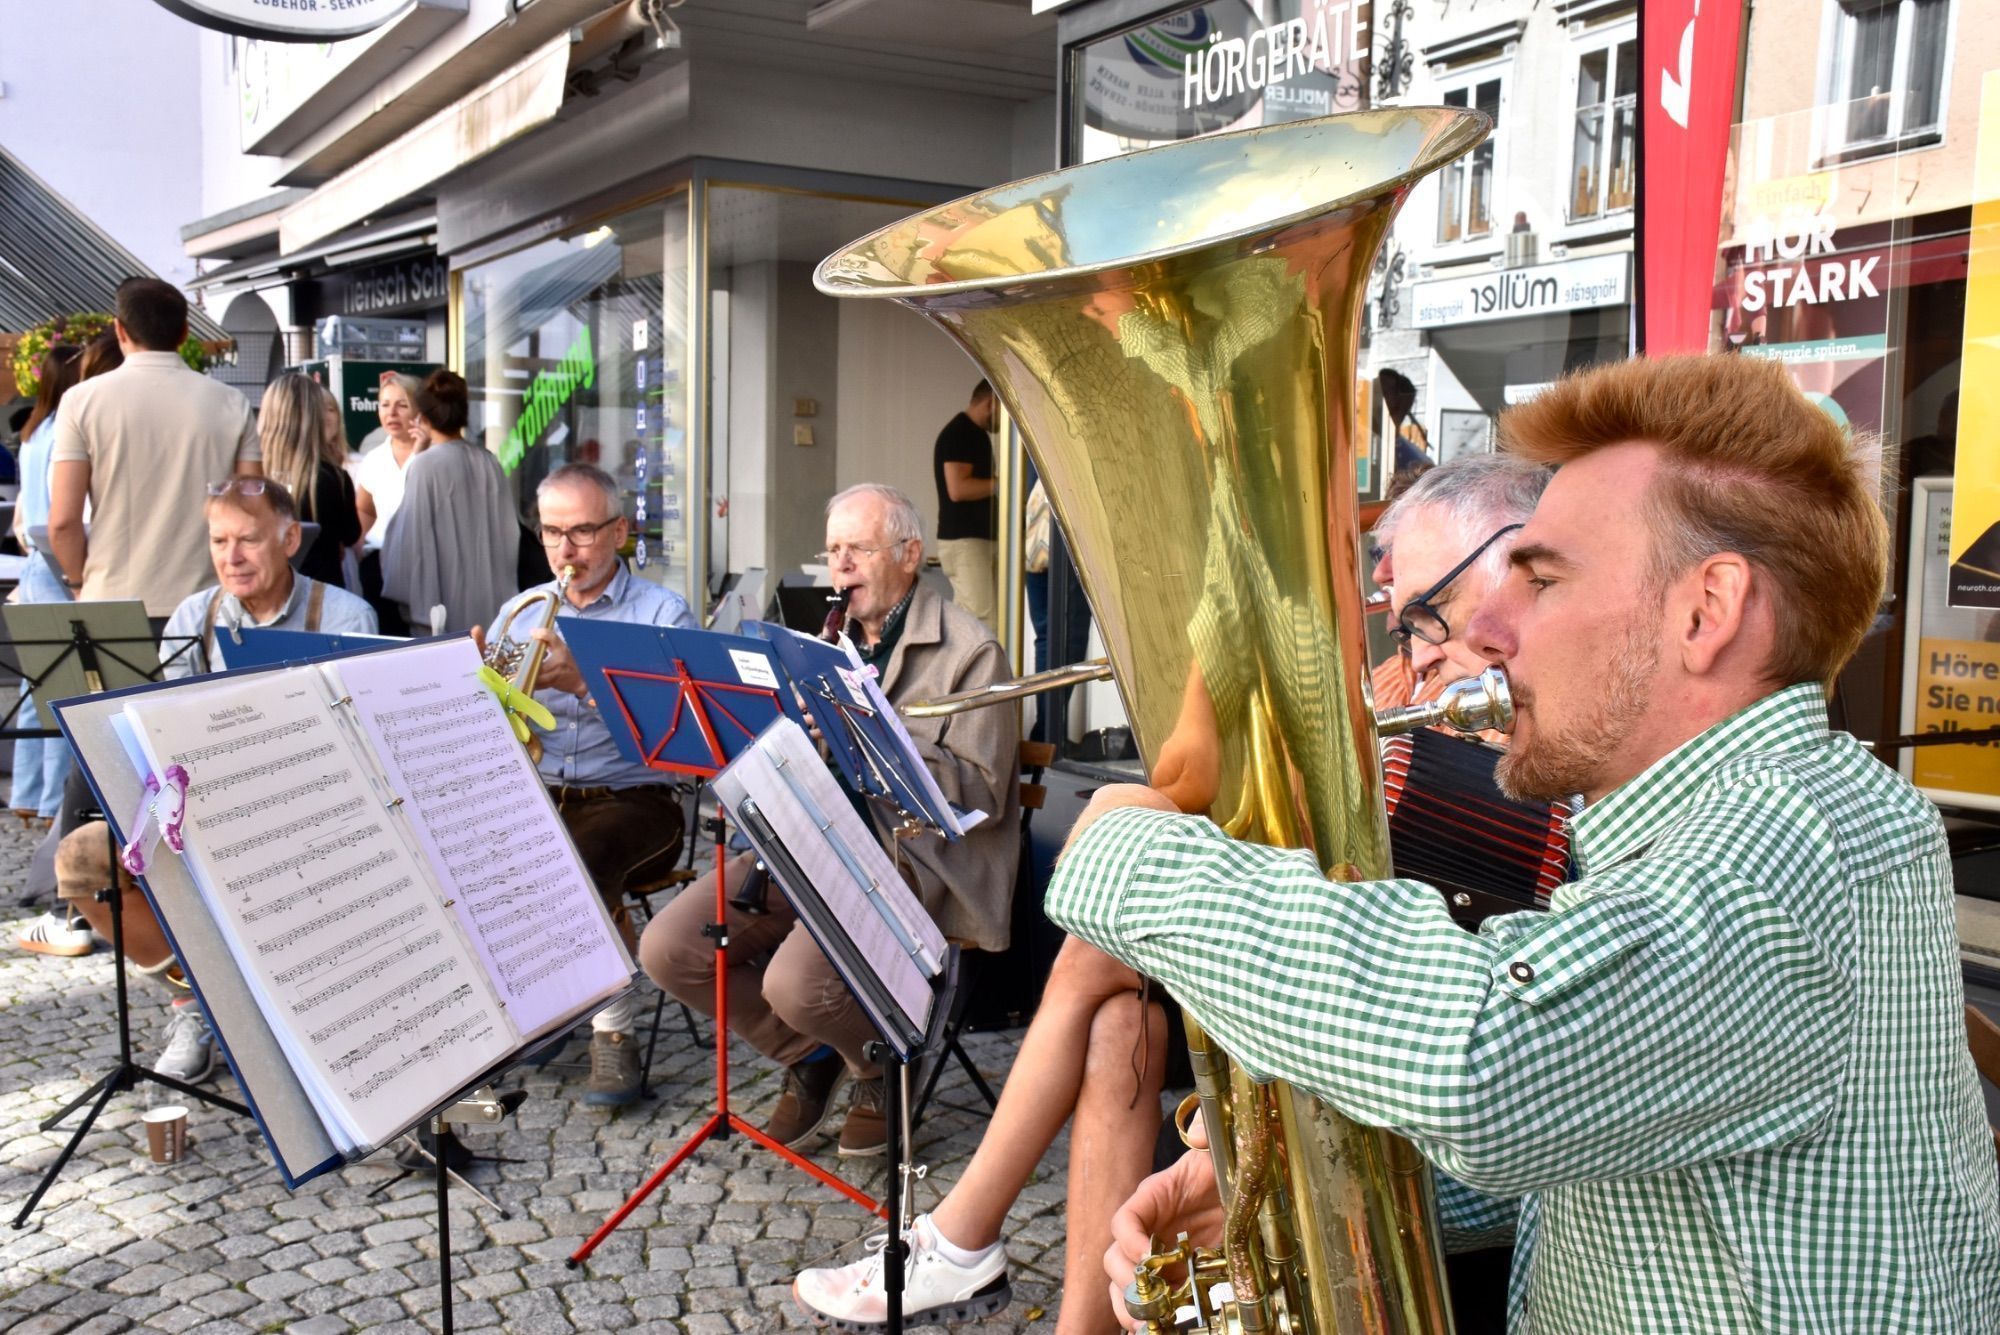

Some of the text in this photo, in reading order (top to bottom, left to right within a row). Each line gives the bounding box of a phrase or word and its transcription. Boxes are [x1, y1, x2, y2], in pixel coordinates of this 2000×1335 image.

[1184, 0, 1370, 110] HÖRGERÄTE
[411, 256, 450, 301] Sch
[1742, 256, 1881, 312] STARK
[1927, 685, 1970, 711] Sie
